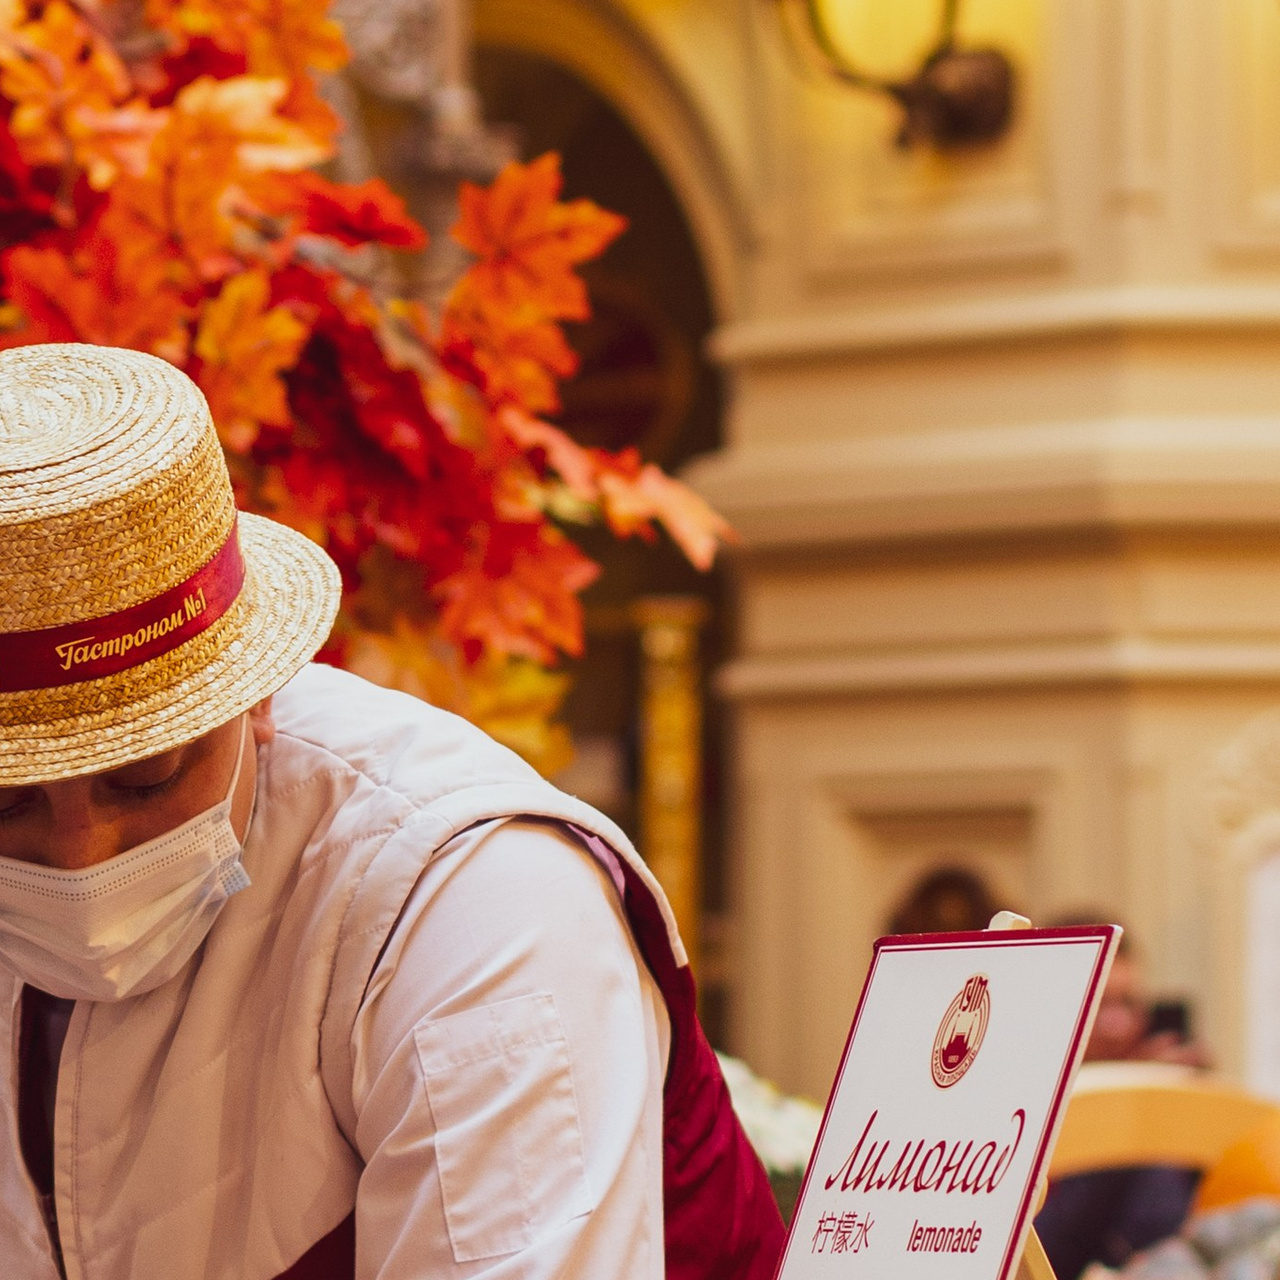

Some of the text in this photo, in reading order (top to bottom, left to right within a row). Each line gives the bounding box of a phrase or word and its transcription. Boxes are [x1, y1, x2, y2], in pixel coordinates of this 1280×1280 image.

[55, 587, 207, 671] Гастроном №1
[958, 975, 989, 1013] ГУМ
[824, 1108, 1027, 1195] Лимонад
[810, 1210, 875, 1255] 柠檬水
[906, 1219, 983, 1253] lemonade
